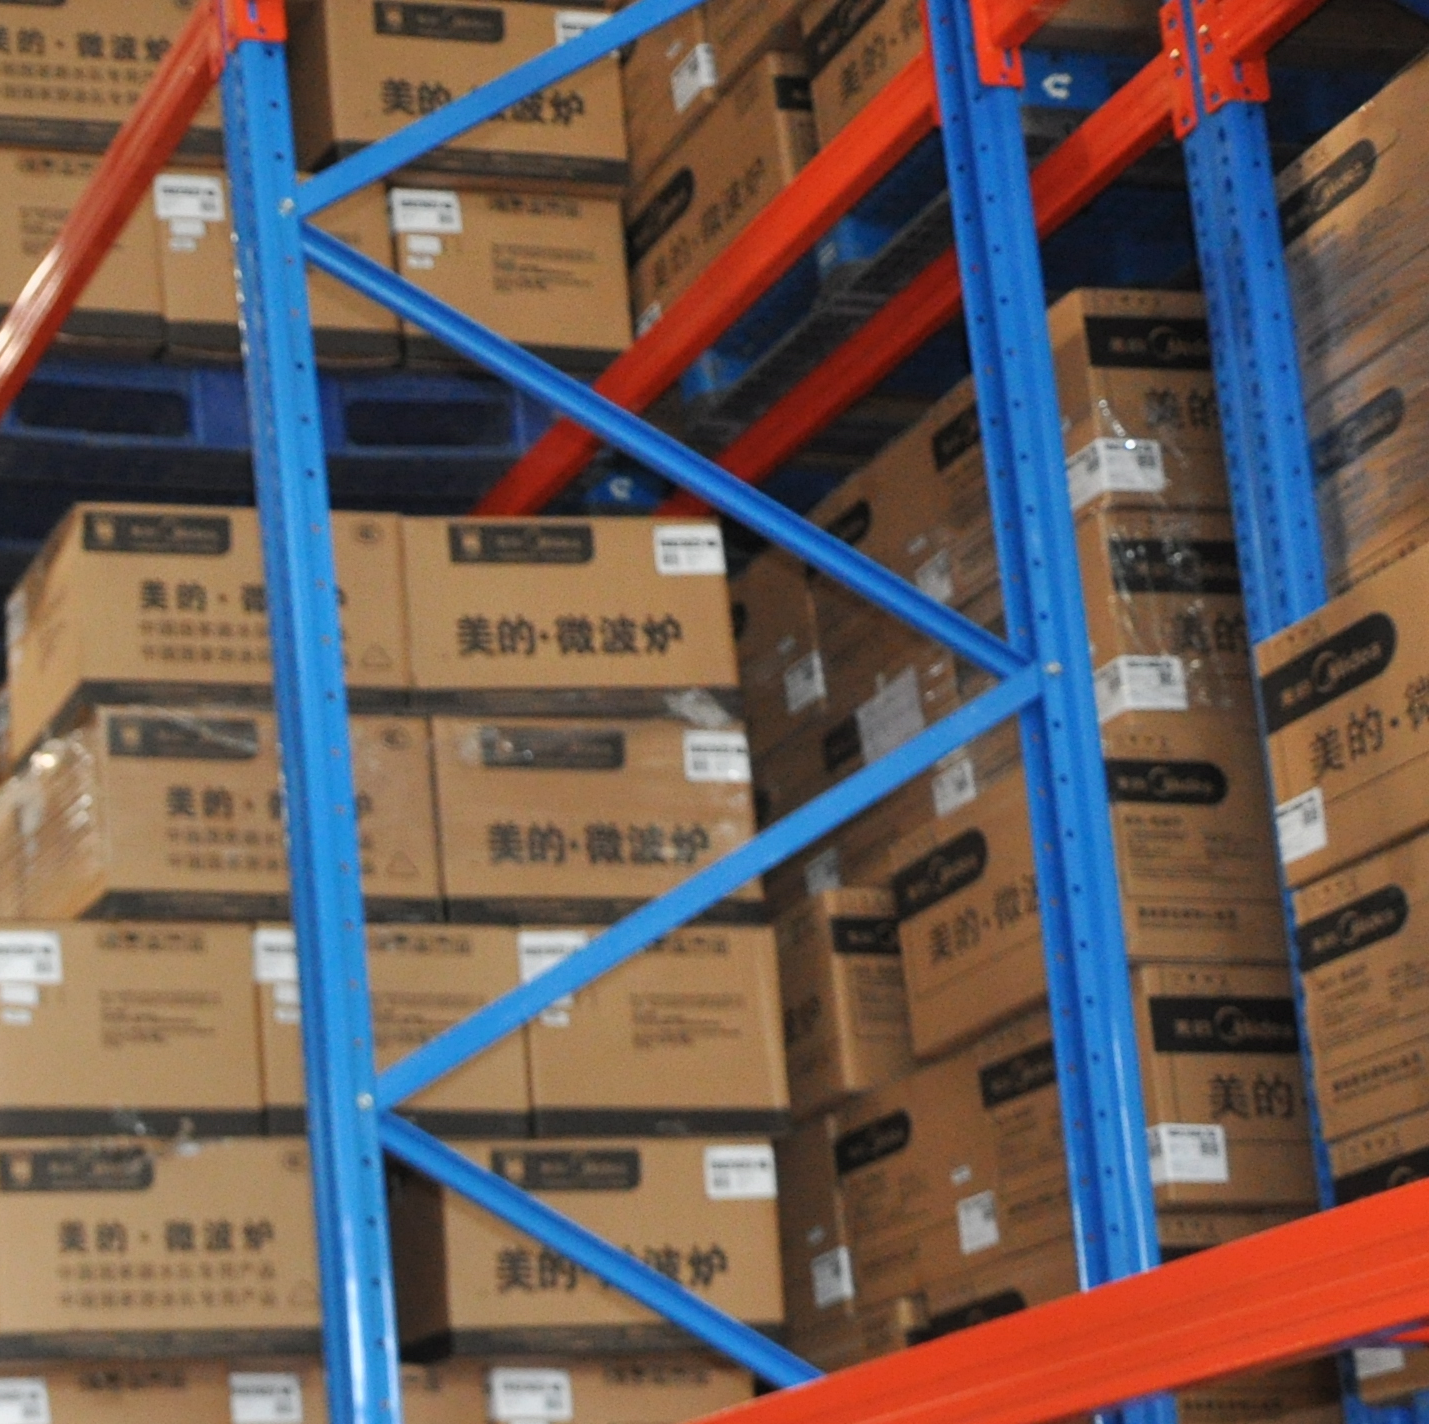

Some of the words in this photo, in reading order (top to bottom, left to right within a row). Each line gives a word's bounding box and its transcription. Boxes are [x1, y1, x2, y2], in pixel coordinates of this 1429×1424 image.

[458, 613, 683, 658] 美的·微波炉
